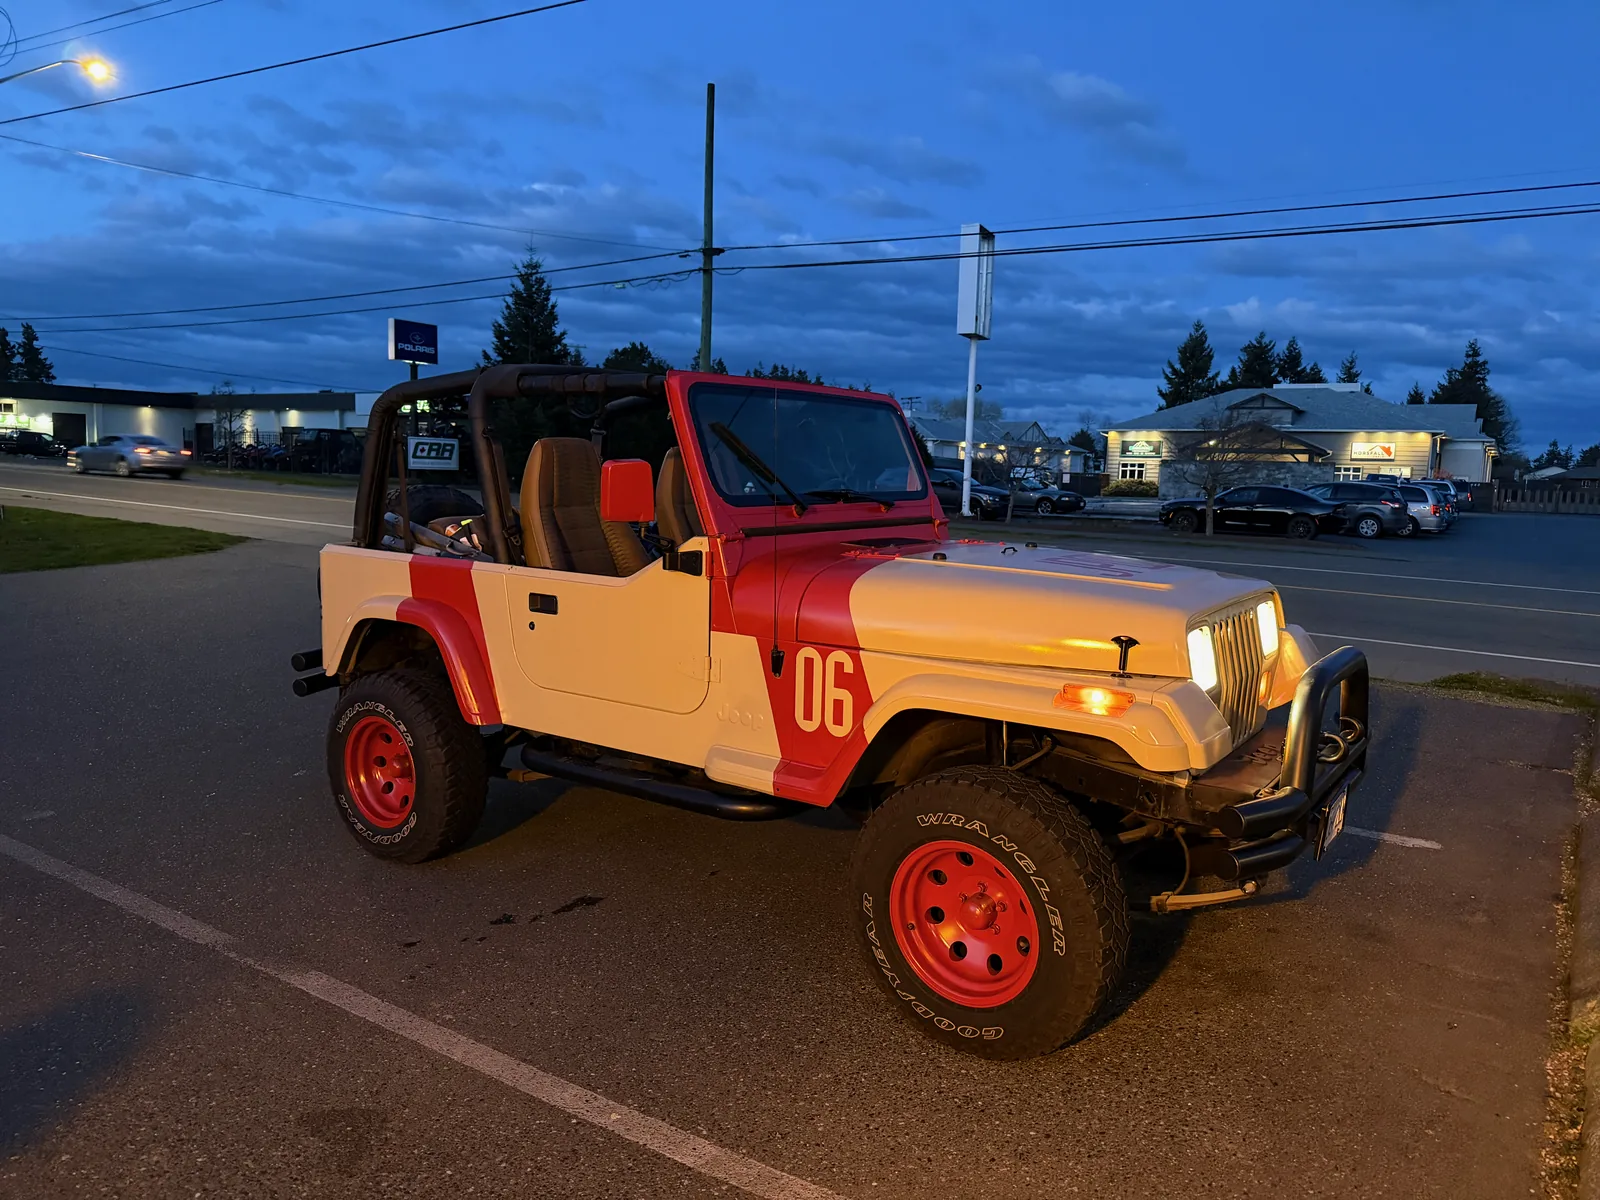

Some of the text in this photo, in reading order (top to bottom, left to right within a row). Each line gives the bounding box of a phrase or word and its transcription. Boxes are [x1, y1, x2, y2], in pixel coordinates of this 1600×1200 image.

[398, 343, 435, 354] POLARIS
[412, 442, 455, 460] CAA
[795, 646, 854, 737] 06
[336, 701, 414, 747] WRANGLER
[338, 794, 418, 844] GOODYEAR
[916, 812, 1066, 957] WRANGLER
[863, 892, 1004, 1040] GOODYEAR
